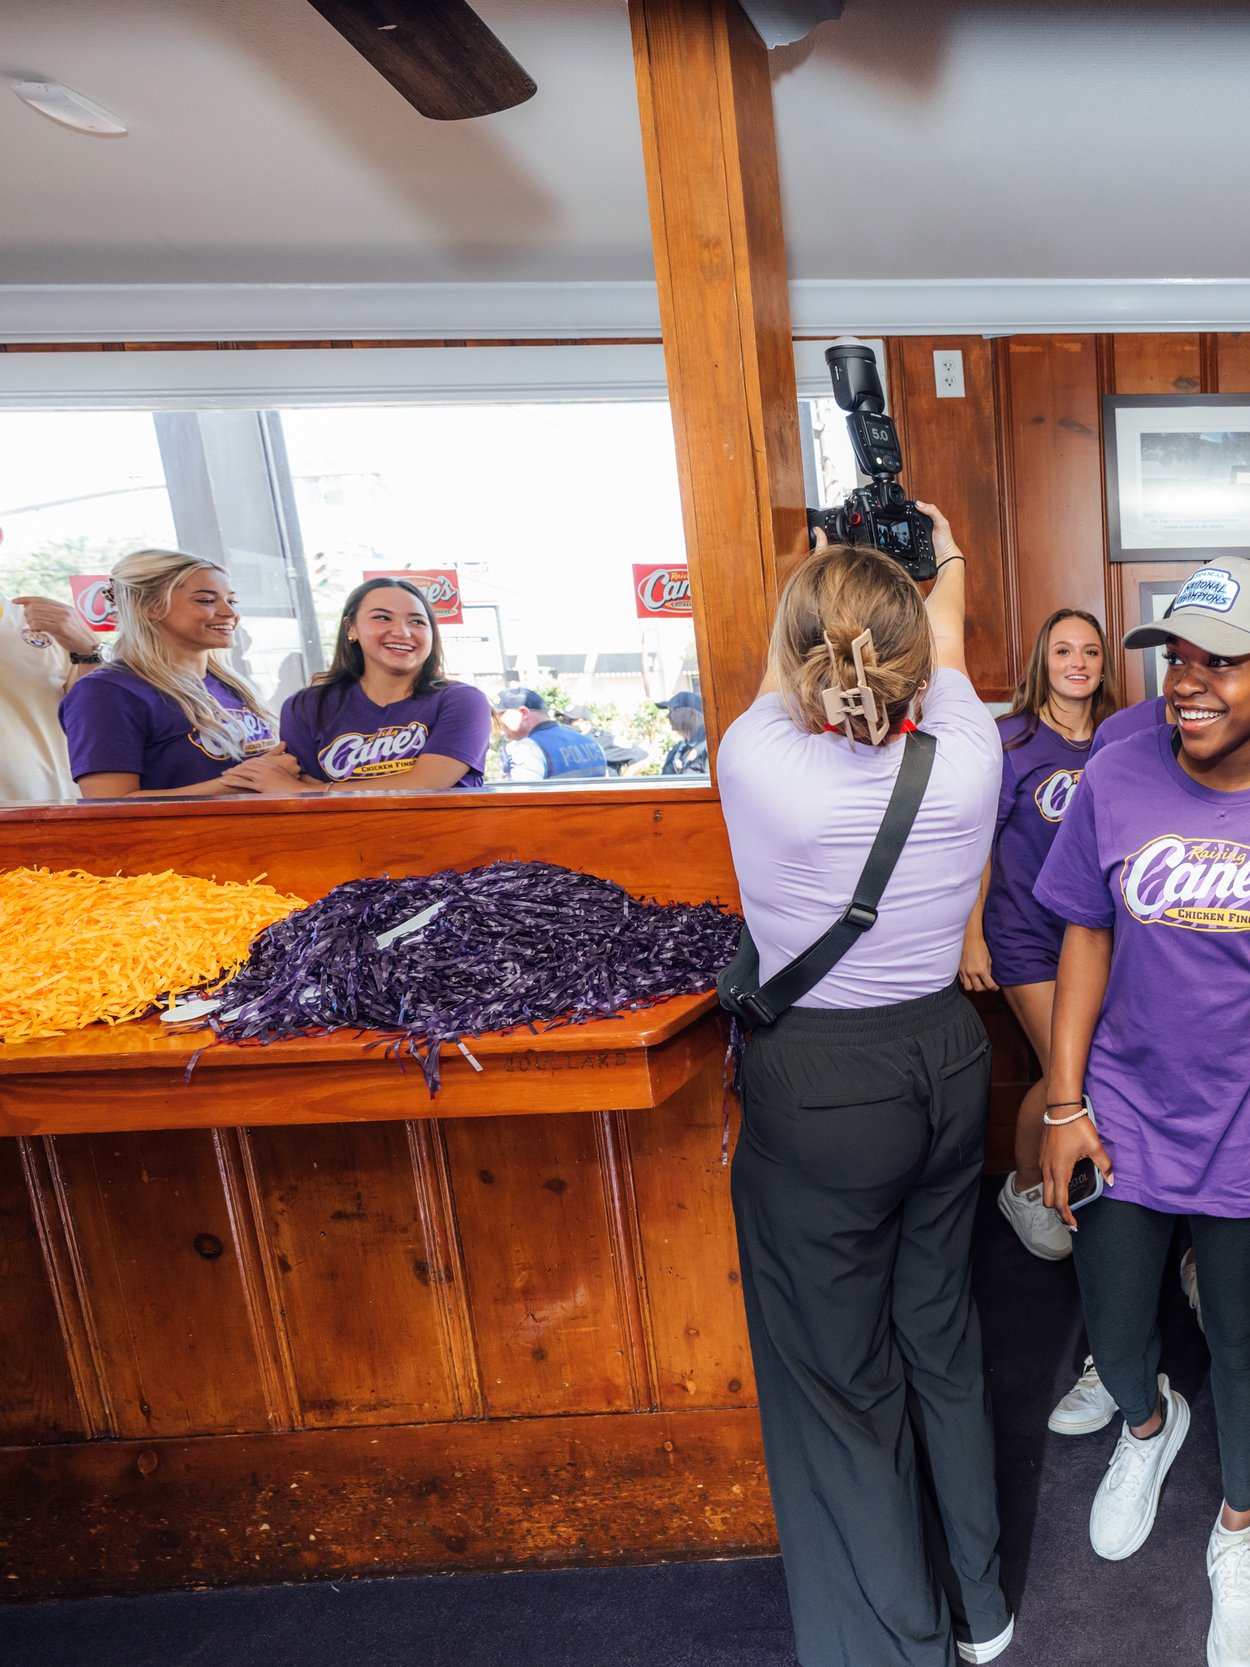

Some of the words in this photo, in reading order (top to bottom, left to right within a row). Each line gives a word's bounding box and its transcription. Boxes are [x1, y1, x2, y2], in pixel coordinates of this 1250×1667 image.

[872, 427, 888, 442] 5.0
[643, 569, 691, 609] Can
[324, 723, 426, 778] Cane's
[1188, 845, 1248, 866] Raising
[1177, 908, 1225, 922] CHICKEN
